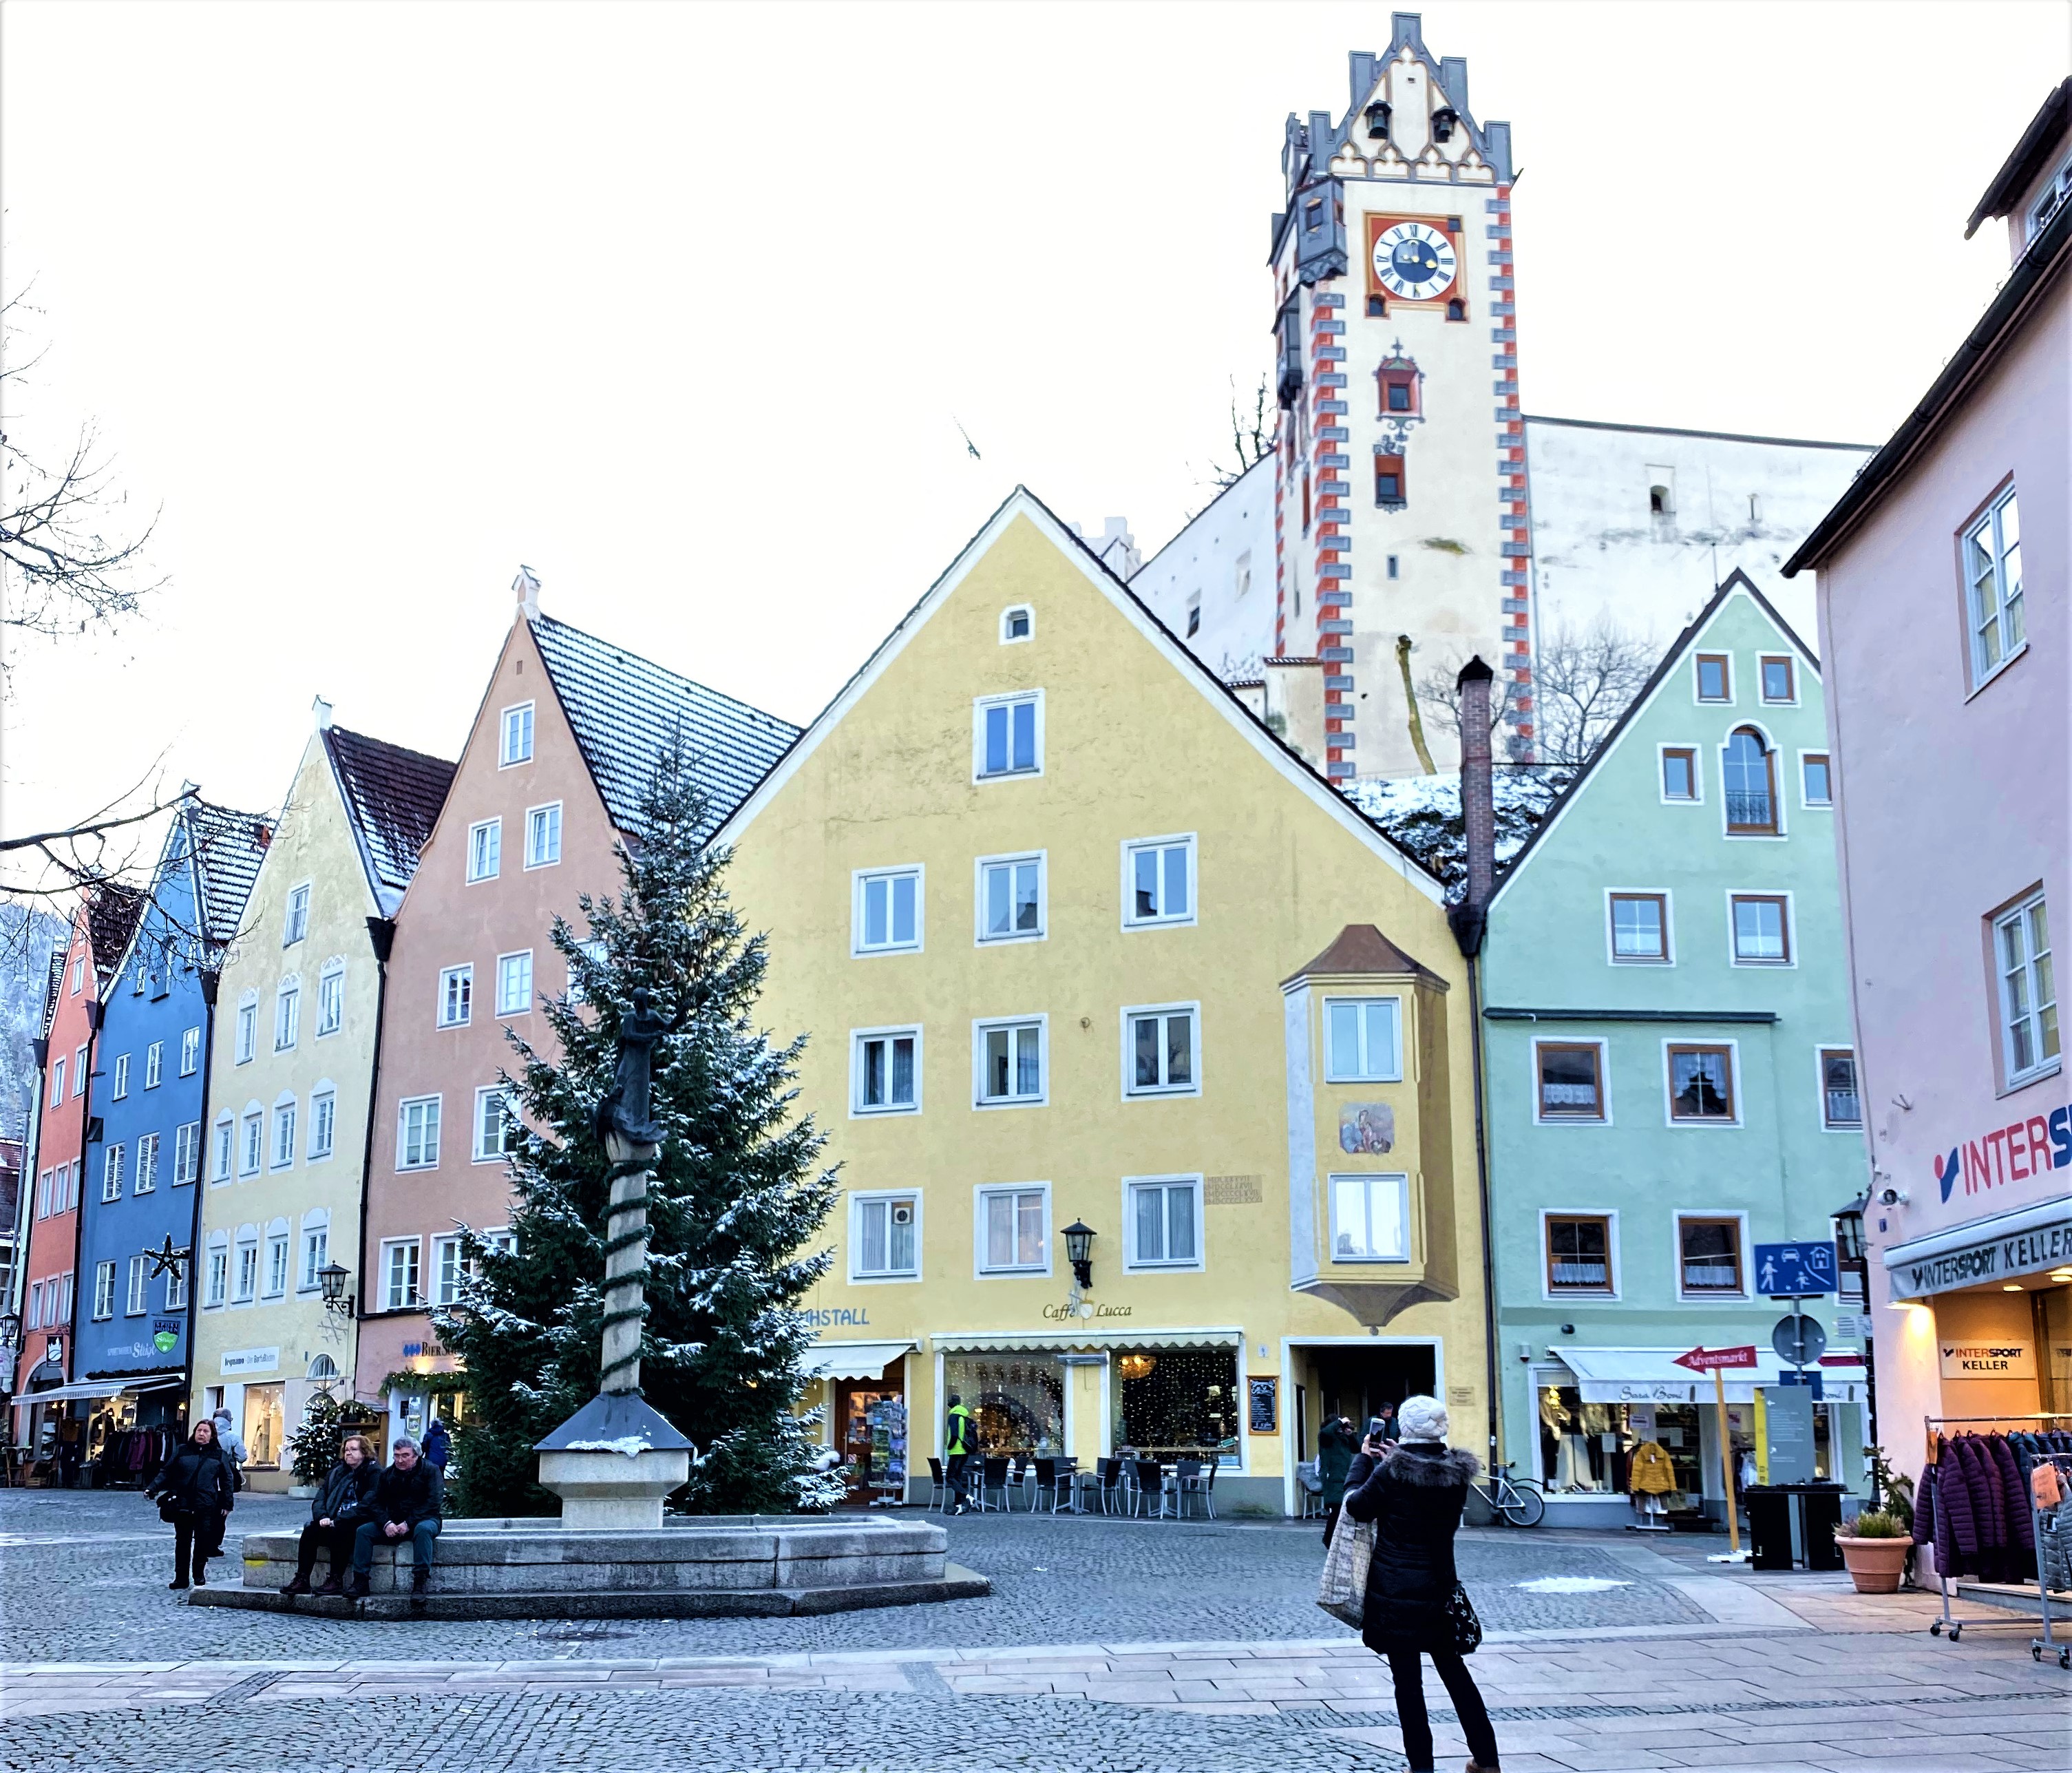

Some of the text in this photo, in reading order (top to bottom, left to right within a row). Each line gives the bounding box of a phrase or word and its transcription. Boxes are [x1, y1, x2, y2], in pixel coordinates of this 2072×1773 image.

[1962, 1104, 2072, 1197] INTERS
[1924, 1246, 1998, 1289] INTERSPORT
[805, 1308, 870, 1327] HSTALL
[1096, 1303, 1132, 1317] Lucca
[1688, 1350, 1748, 1367] Adventsmarkt
[1956, 1348, 2025, 1358] INTERSPORT
[1962, 1361, 2009, 1370] KELLER
